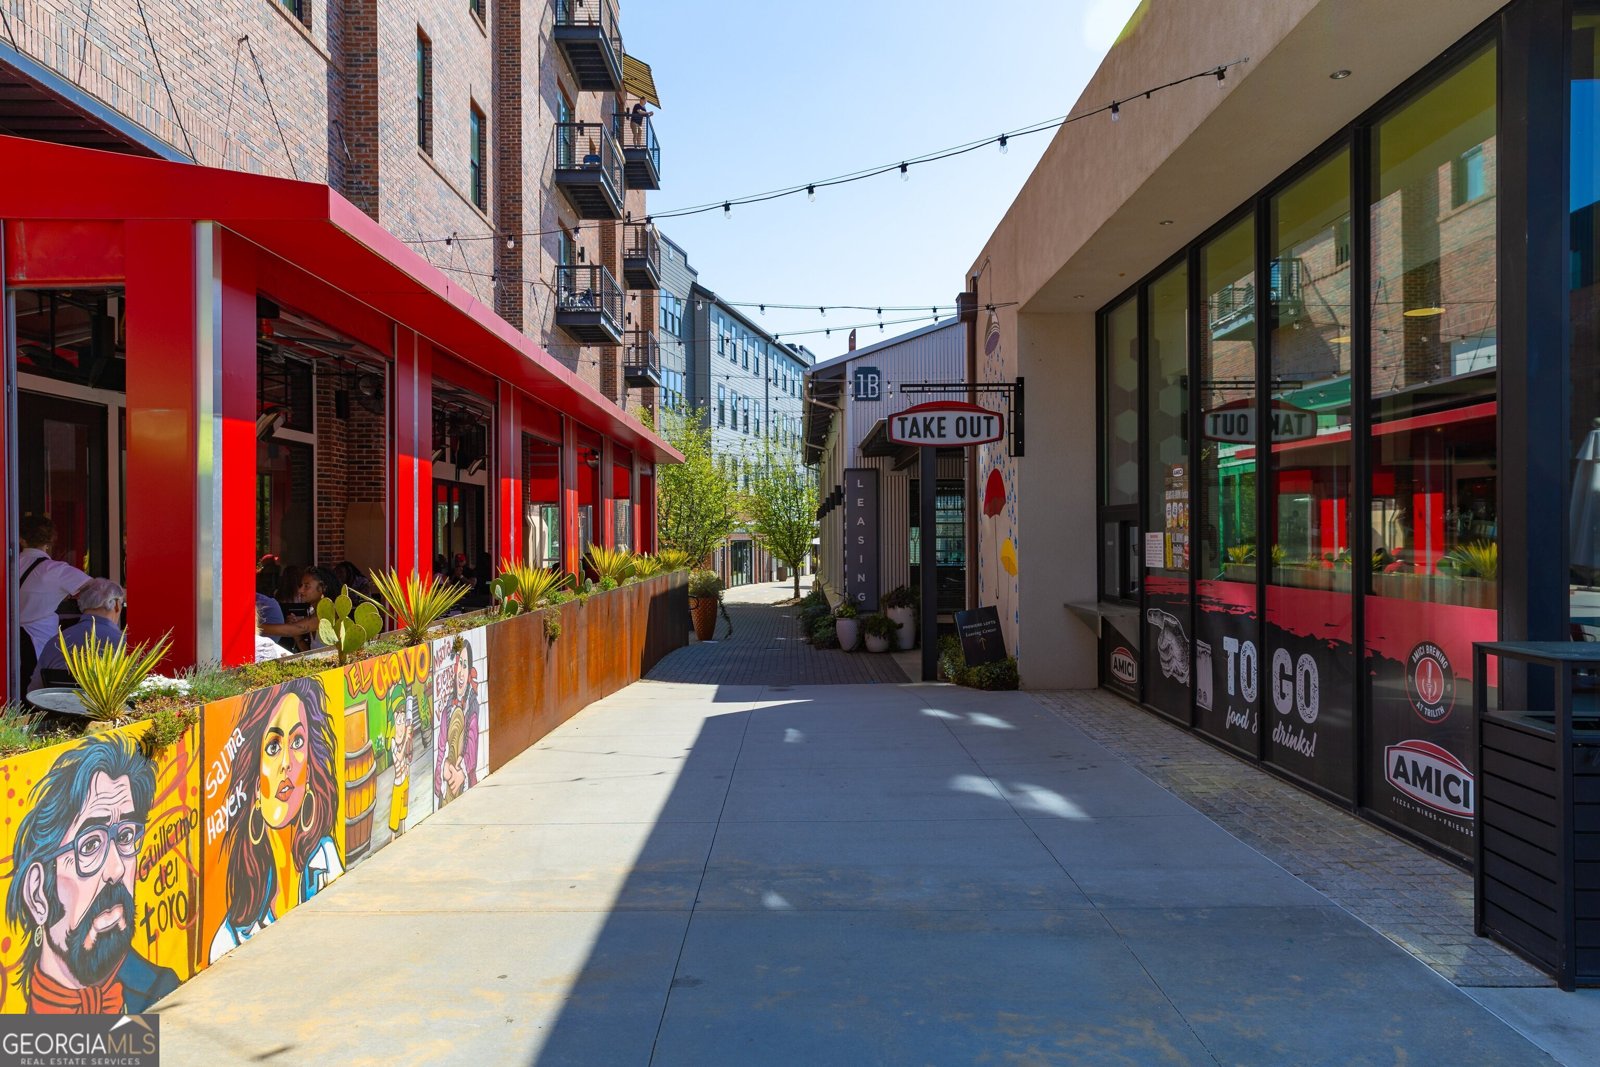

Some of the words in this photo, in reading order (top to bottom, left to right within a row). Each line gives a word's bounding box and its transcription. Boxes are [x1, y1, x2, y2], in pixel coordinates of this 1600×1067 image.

[857, 374, 879, 399] 1B
[898, 416, 947, 439] TAKE
[955, 415, 994, 438] OUT
[857, 479, 866, 602] LEASING
[1113, 656, 1135, 679] AMICI
[1426, 644, 1449, 669] BREWING
[1223, 636, 1258, 703] TO
[1272, 648, 1319, 724] GO
[1226, 706, 1249, 729] food
[1424, 705, 1445, 719] TRILITH
[1272, 721, 1317, 757] drinks!
[206, 727, 245, 799] Salma
[1392, 755, 1471, 809] AMICI
[207, 780, 247, 845] Hayek
[1392, 796, 1410, 809] PIZZA
[1416, 807, 1437, 821] WINGS
[1443, 818, 1474, 837] FRIENDS
[139, 808, 198, 882] Guillermo
[154, 857, 178, 896] del
